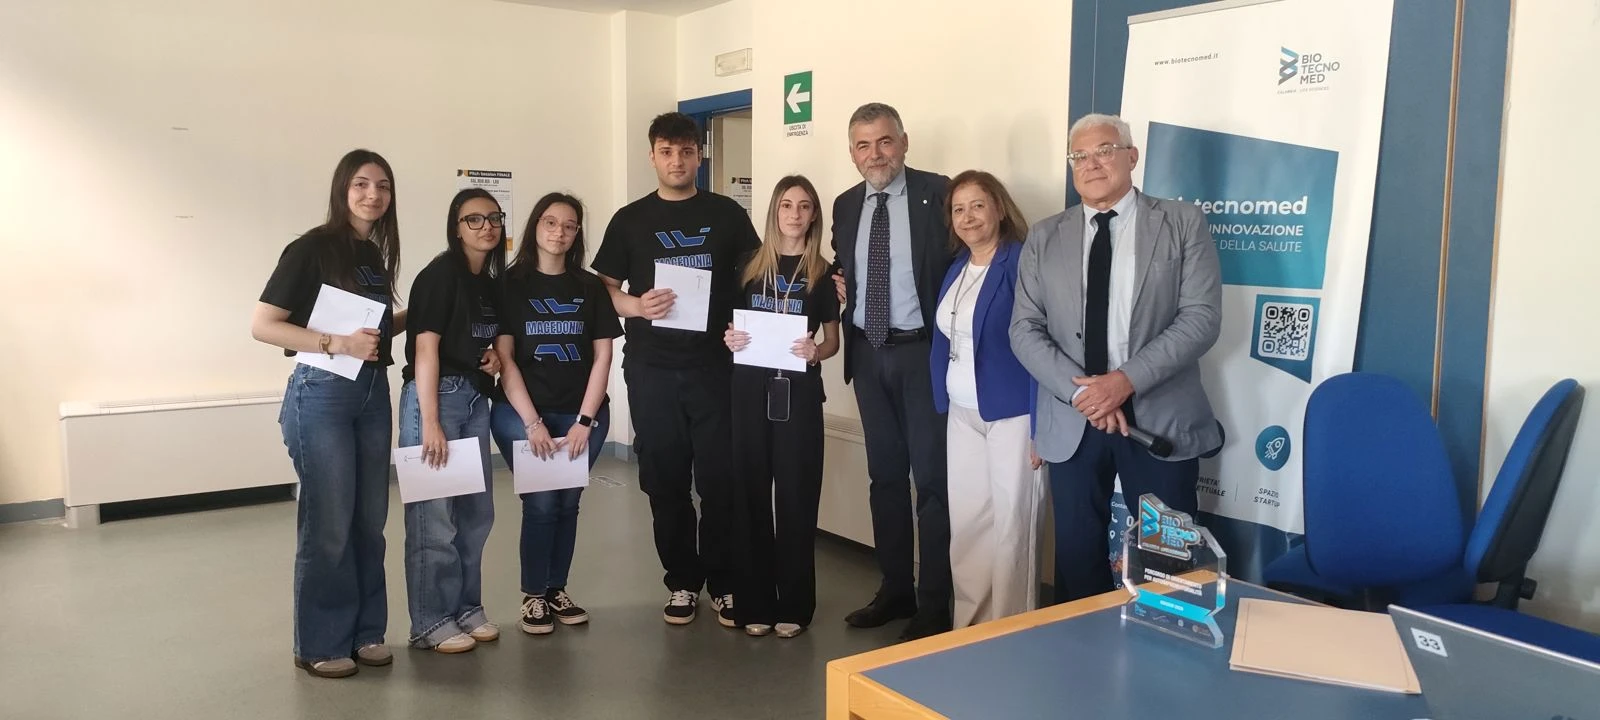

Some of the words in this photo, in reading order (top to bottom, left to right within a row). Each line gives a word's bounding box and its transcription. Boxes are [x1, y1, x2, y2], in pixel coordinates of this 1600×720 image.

[1154, 52, 1219, 67] www.biotecnomed.it
[1301, 53, 1322, 64] BIO
[1301, 61, 1340, 75] TECNO
[1300, 73, 1326, 85] MED
[1167, 196, 1308, 215] ecnomed
[1220, 239, 1256, 251] DELLA
[1258, 240, 1303, 252] SALUTE
[525, 320, 585, 336] MACEDONIA
[1253, 496, 1281, 508] STARTUP
[1161, 515, 1181, 528] BIO
[1161, 525, 1198, 542] TECNO
[1418, 635, 1440, 650] 33
